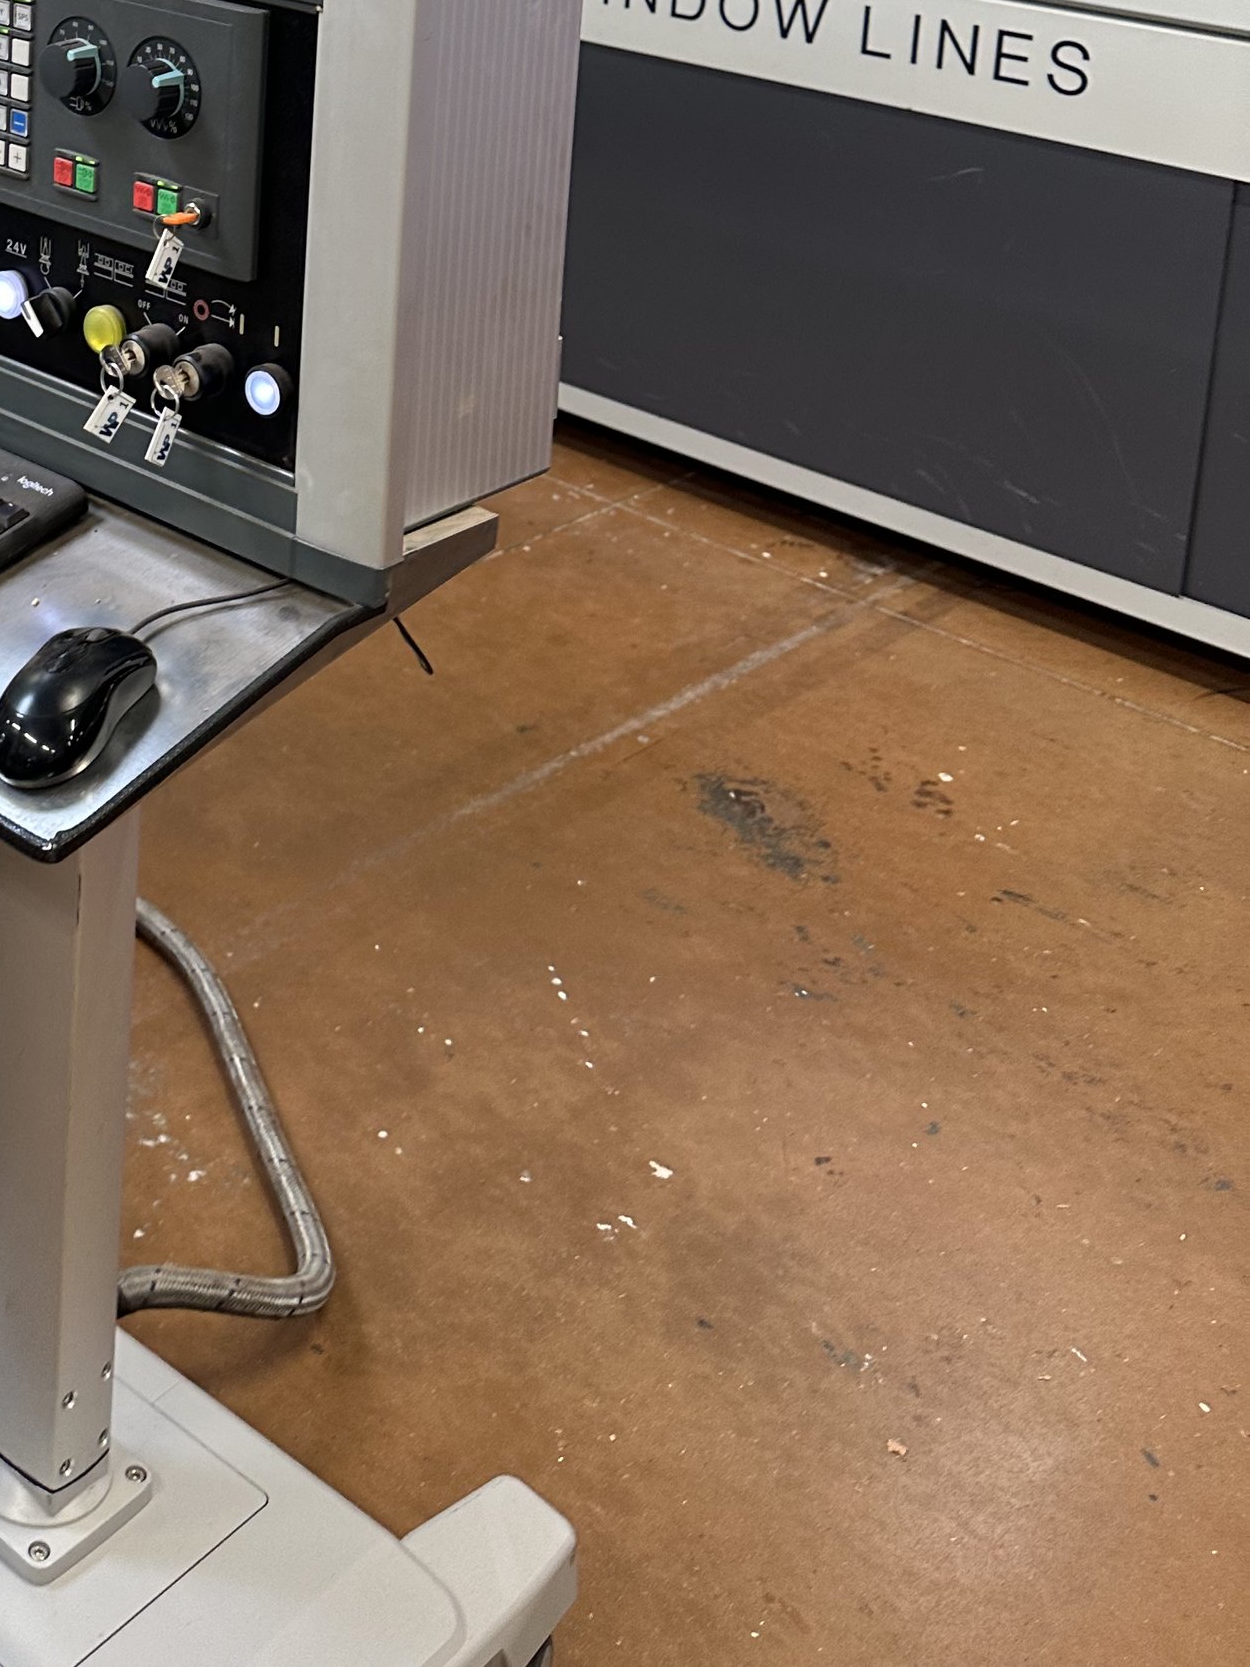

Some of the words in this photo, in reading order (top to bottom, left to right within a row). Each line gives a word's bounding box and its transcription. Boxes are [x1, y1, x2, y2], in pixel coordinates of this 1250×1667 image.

[859, 4, 1092, 97] LINES
[6, 238, 27, 255] 24V
[137, 299, 151, 310] OFF
[178, 313, 189, 325] ON
[16, 475, 54, 497] logitech
